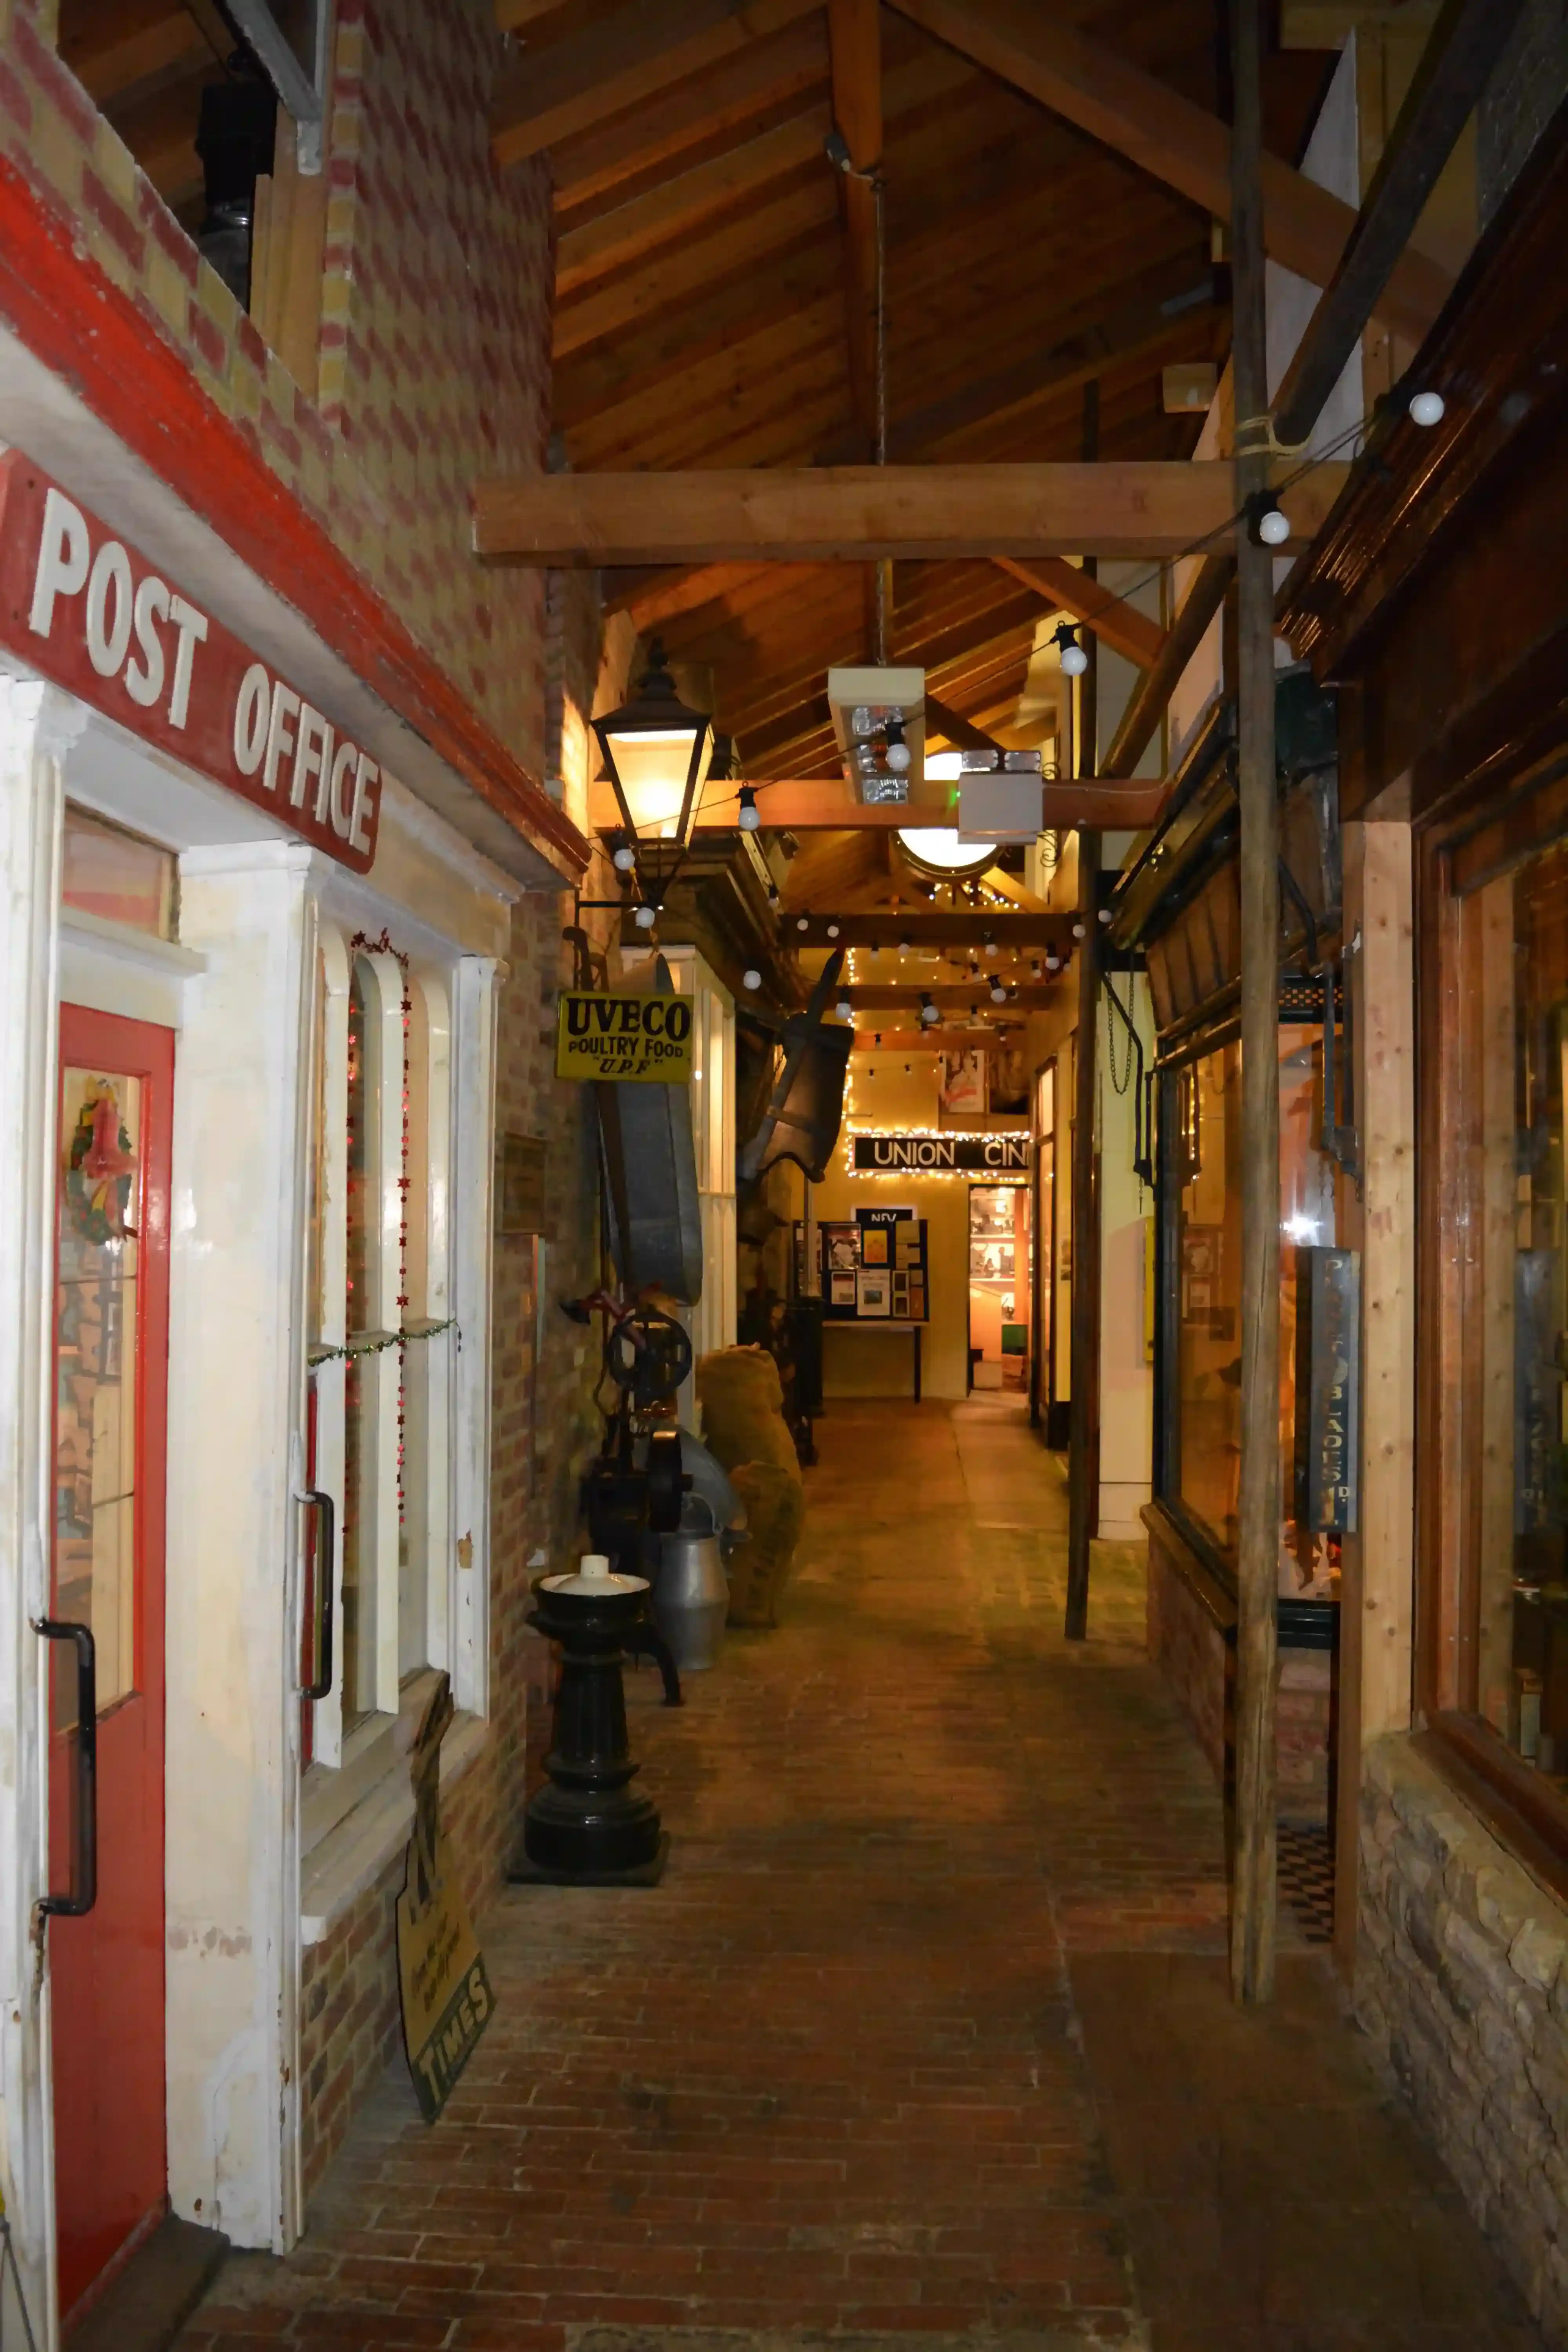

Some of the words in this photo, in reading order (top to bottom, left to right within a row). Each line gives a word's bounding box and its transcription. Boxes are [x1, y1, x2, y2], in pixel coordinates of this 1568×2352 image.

[29, 487, 208, 730] POST
[234, 663, 379, 856] OFFICE
[566, 998, 690, 1042] UVECO
[569, 1036, 639, 1056] POULTRY
[645, 1038, 683, 1058] FOOD
[875, 1141, 955, 1166] UNION
[984, 1142, 1029, 1166] CIN
[419, 1967, 488, 2104] TIMES
